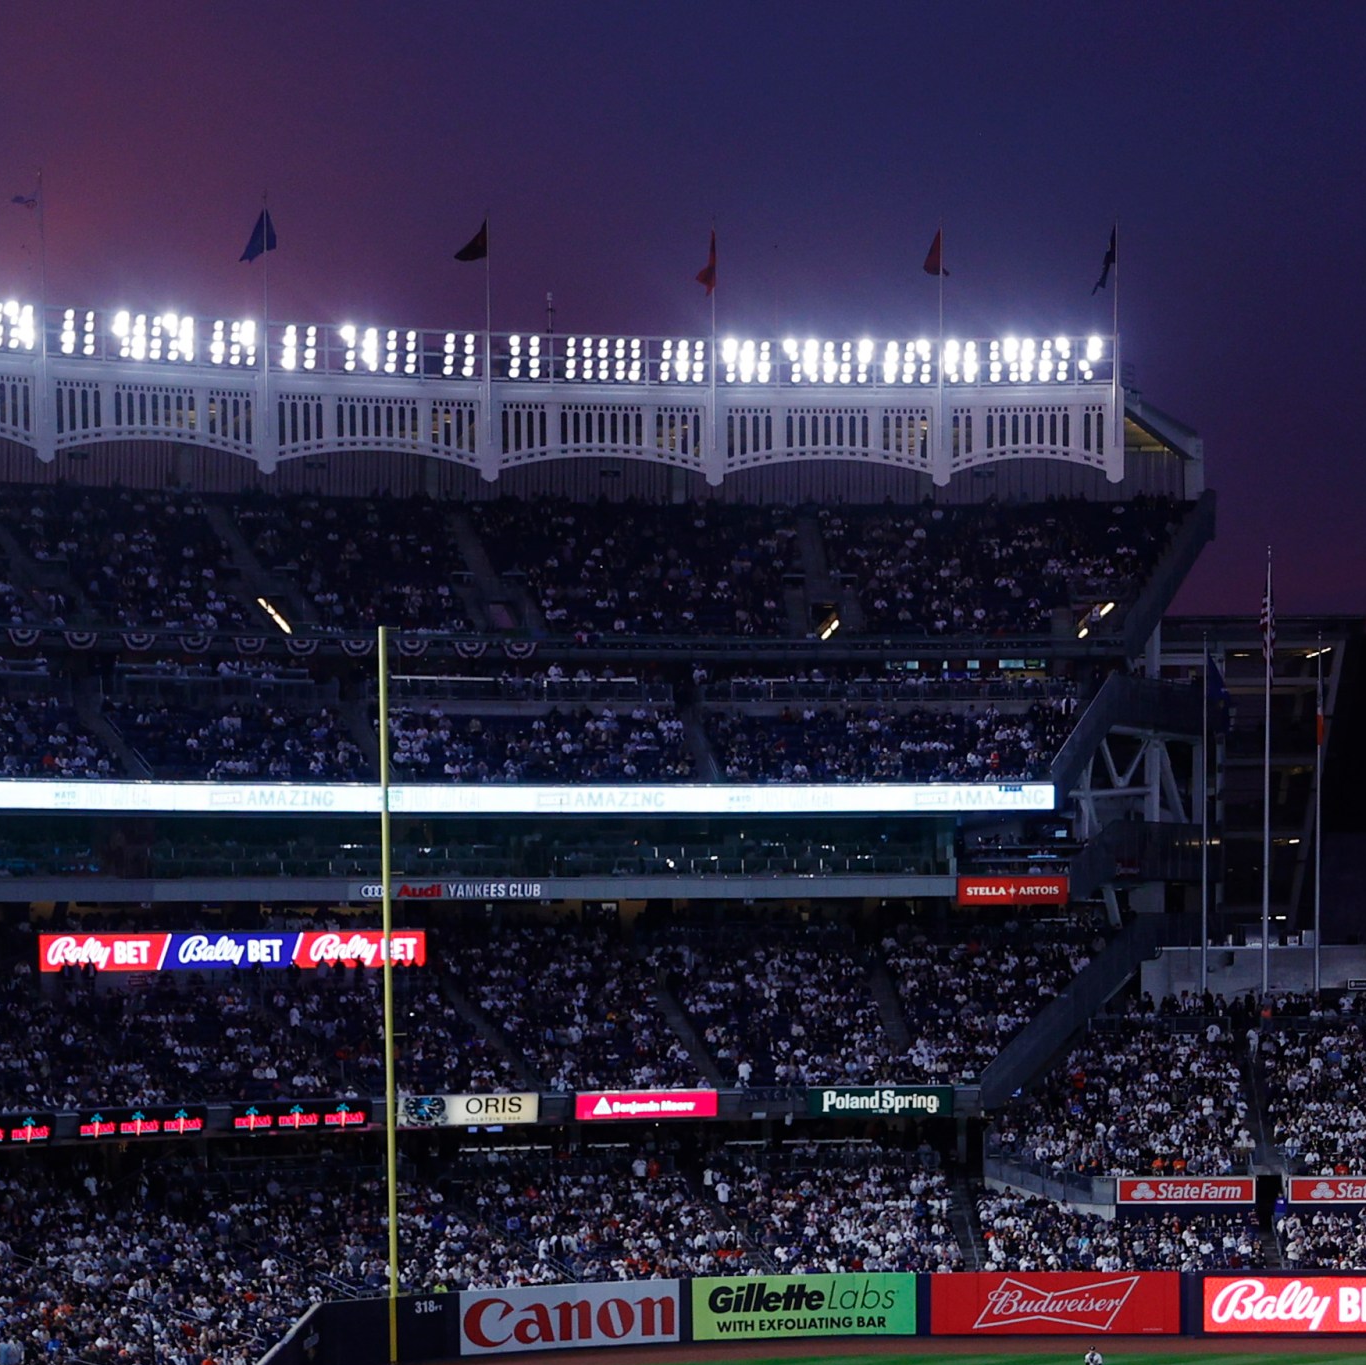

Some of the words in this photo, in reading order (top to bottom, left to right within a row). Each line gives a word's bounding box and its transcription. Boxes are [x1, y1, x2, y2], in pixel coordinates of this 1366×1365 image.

[397, 883, 442, 898] Audi
[448, 883, 505, 898] YANKEES
[509, 883, 541, 897] CLUB
[966, 884, 1006, 896] STELLA
[1019, 884, 1059, 896] ARTOIS
[46, 934, 113, 967] Bally
[114, 933, 151, 963] BET
[178, 934, 244, 964] Bally
[248, 933, 283, 961] BET
[310, 933, 377, 963] Bally
[466, 1096, 522, 1114] ORIS
[612, 1101, 659, 1115] Benjamin
[660, 1100, 695, 1113] Moore
[822, 1090, 877, 1113] Poland
[880, 1090, 940, 1114] Spring
[415, 1301, 435, 1313] 318
[708, 1282, 825, 1314] Gillette
[828, 1279, 896, 1311] Labs
[992, 1282, 1123, 1316] Budweiser
[1211, 1279, 1329, 1330] Bally
[462, 1295, 677, 1348] Canon
[717, 1318, 755, 1333] WITH
[758, 1316, 852, 1332] EXFOLIATING
[856, 1315, 887, 1329] BAR
